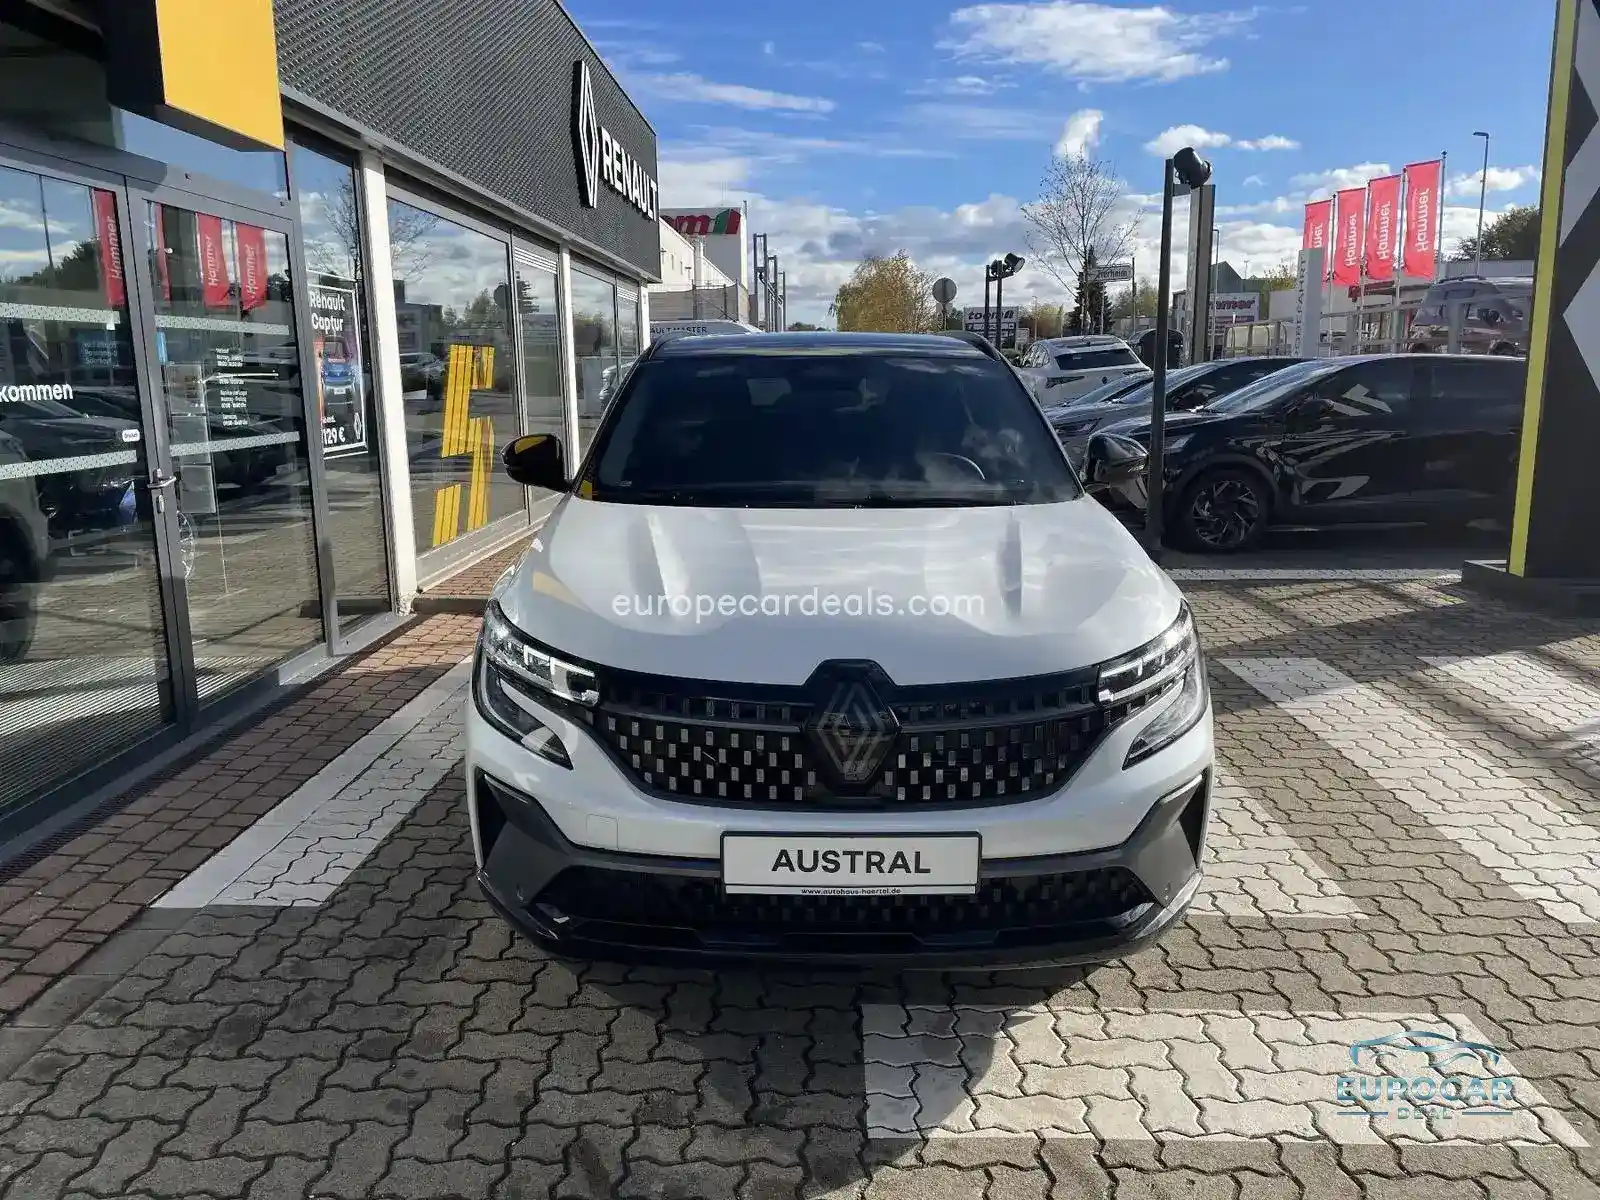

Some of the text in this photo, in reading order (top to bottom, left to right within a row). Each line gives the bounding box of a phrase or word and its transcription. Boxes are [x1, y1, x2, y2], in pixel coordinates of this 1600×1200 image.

[600, 126, 658, 221] RENAULT
[106, 215, 122, 280] Hammer
[204, 234, 218, 287] Hammer
[308, 290, 346, 311] Renault
[311, 312, 344, 335] Captur
[0, 383, 74, 402] kommen
[771, 849, 931, 874] AUSTRAL
[801, 887, 902, 895] www.autohaus-haertel.de
